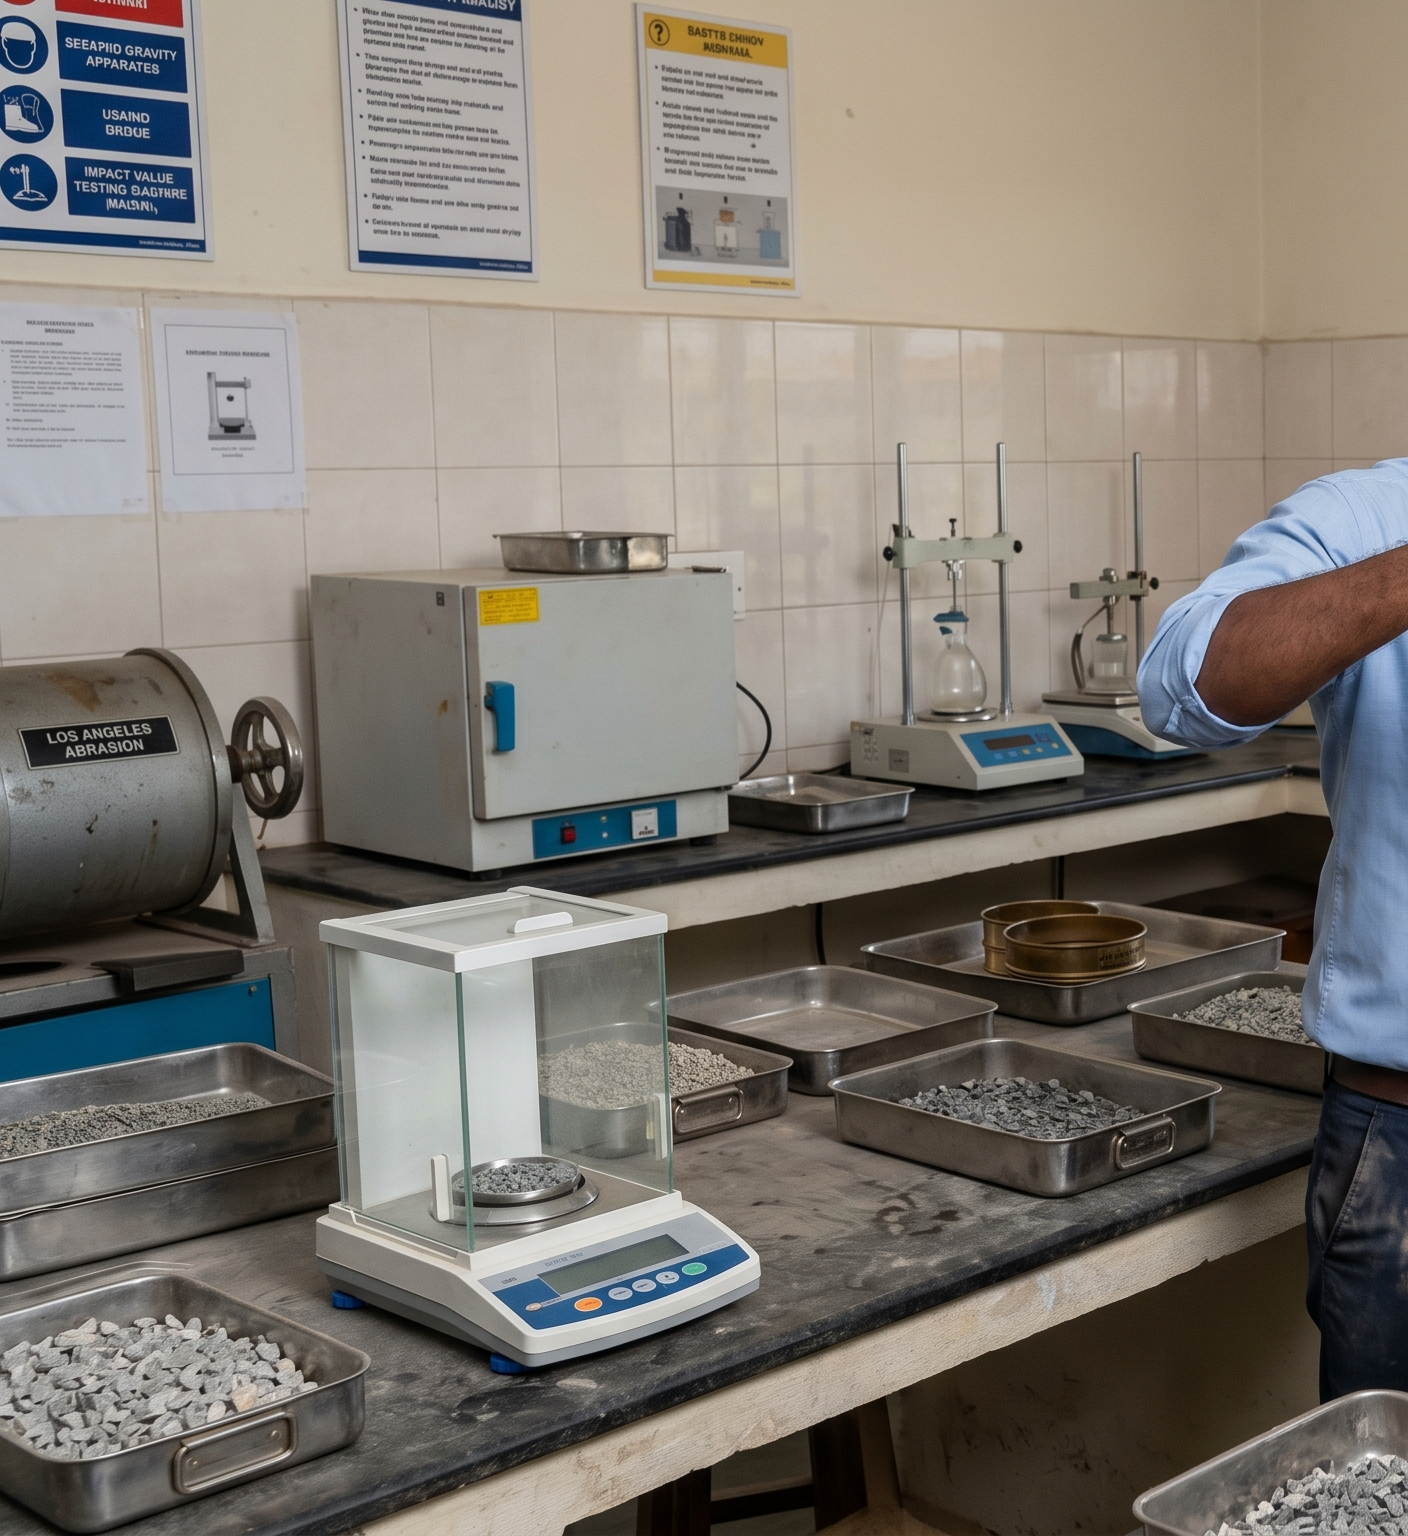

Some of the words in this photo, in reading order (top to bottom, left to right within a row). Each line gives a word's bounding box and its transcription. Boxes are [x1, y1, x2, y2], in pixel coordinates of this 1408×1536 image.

[125, 45, 177, 61] GRAVITY
[86, 55, 160, 75] APPARATES
[84, 166, 131, 181] IMPACT
[133, 170, 174, 184] VALUE
[73, 181, 127, 195] TESTING
[46, 730, 79, 744] LOS
[82, 723, 153, 740] ANGELES
[65, 739, 145, 758] ABRASION
